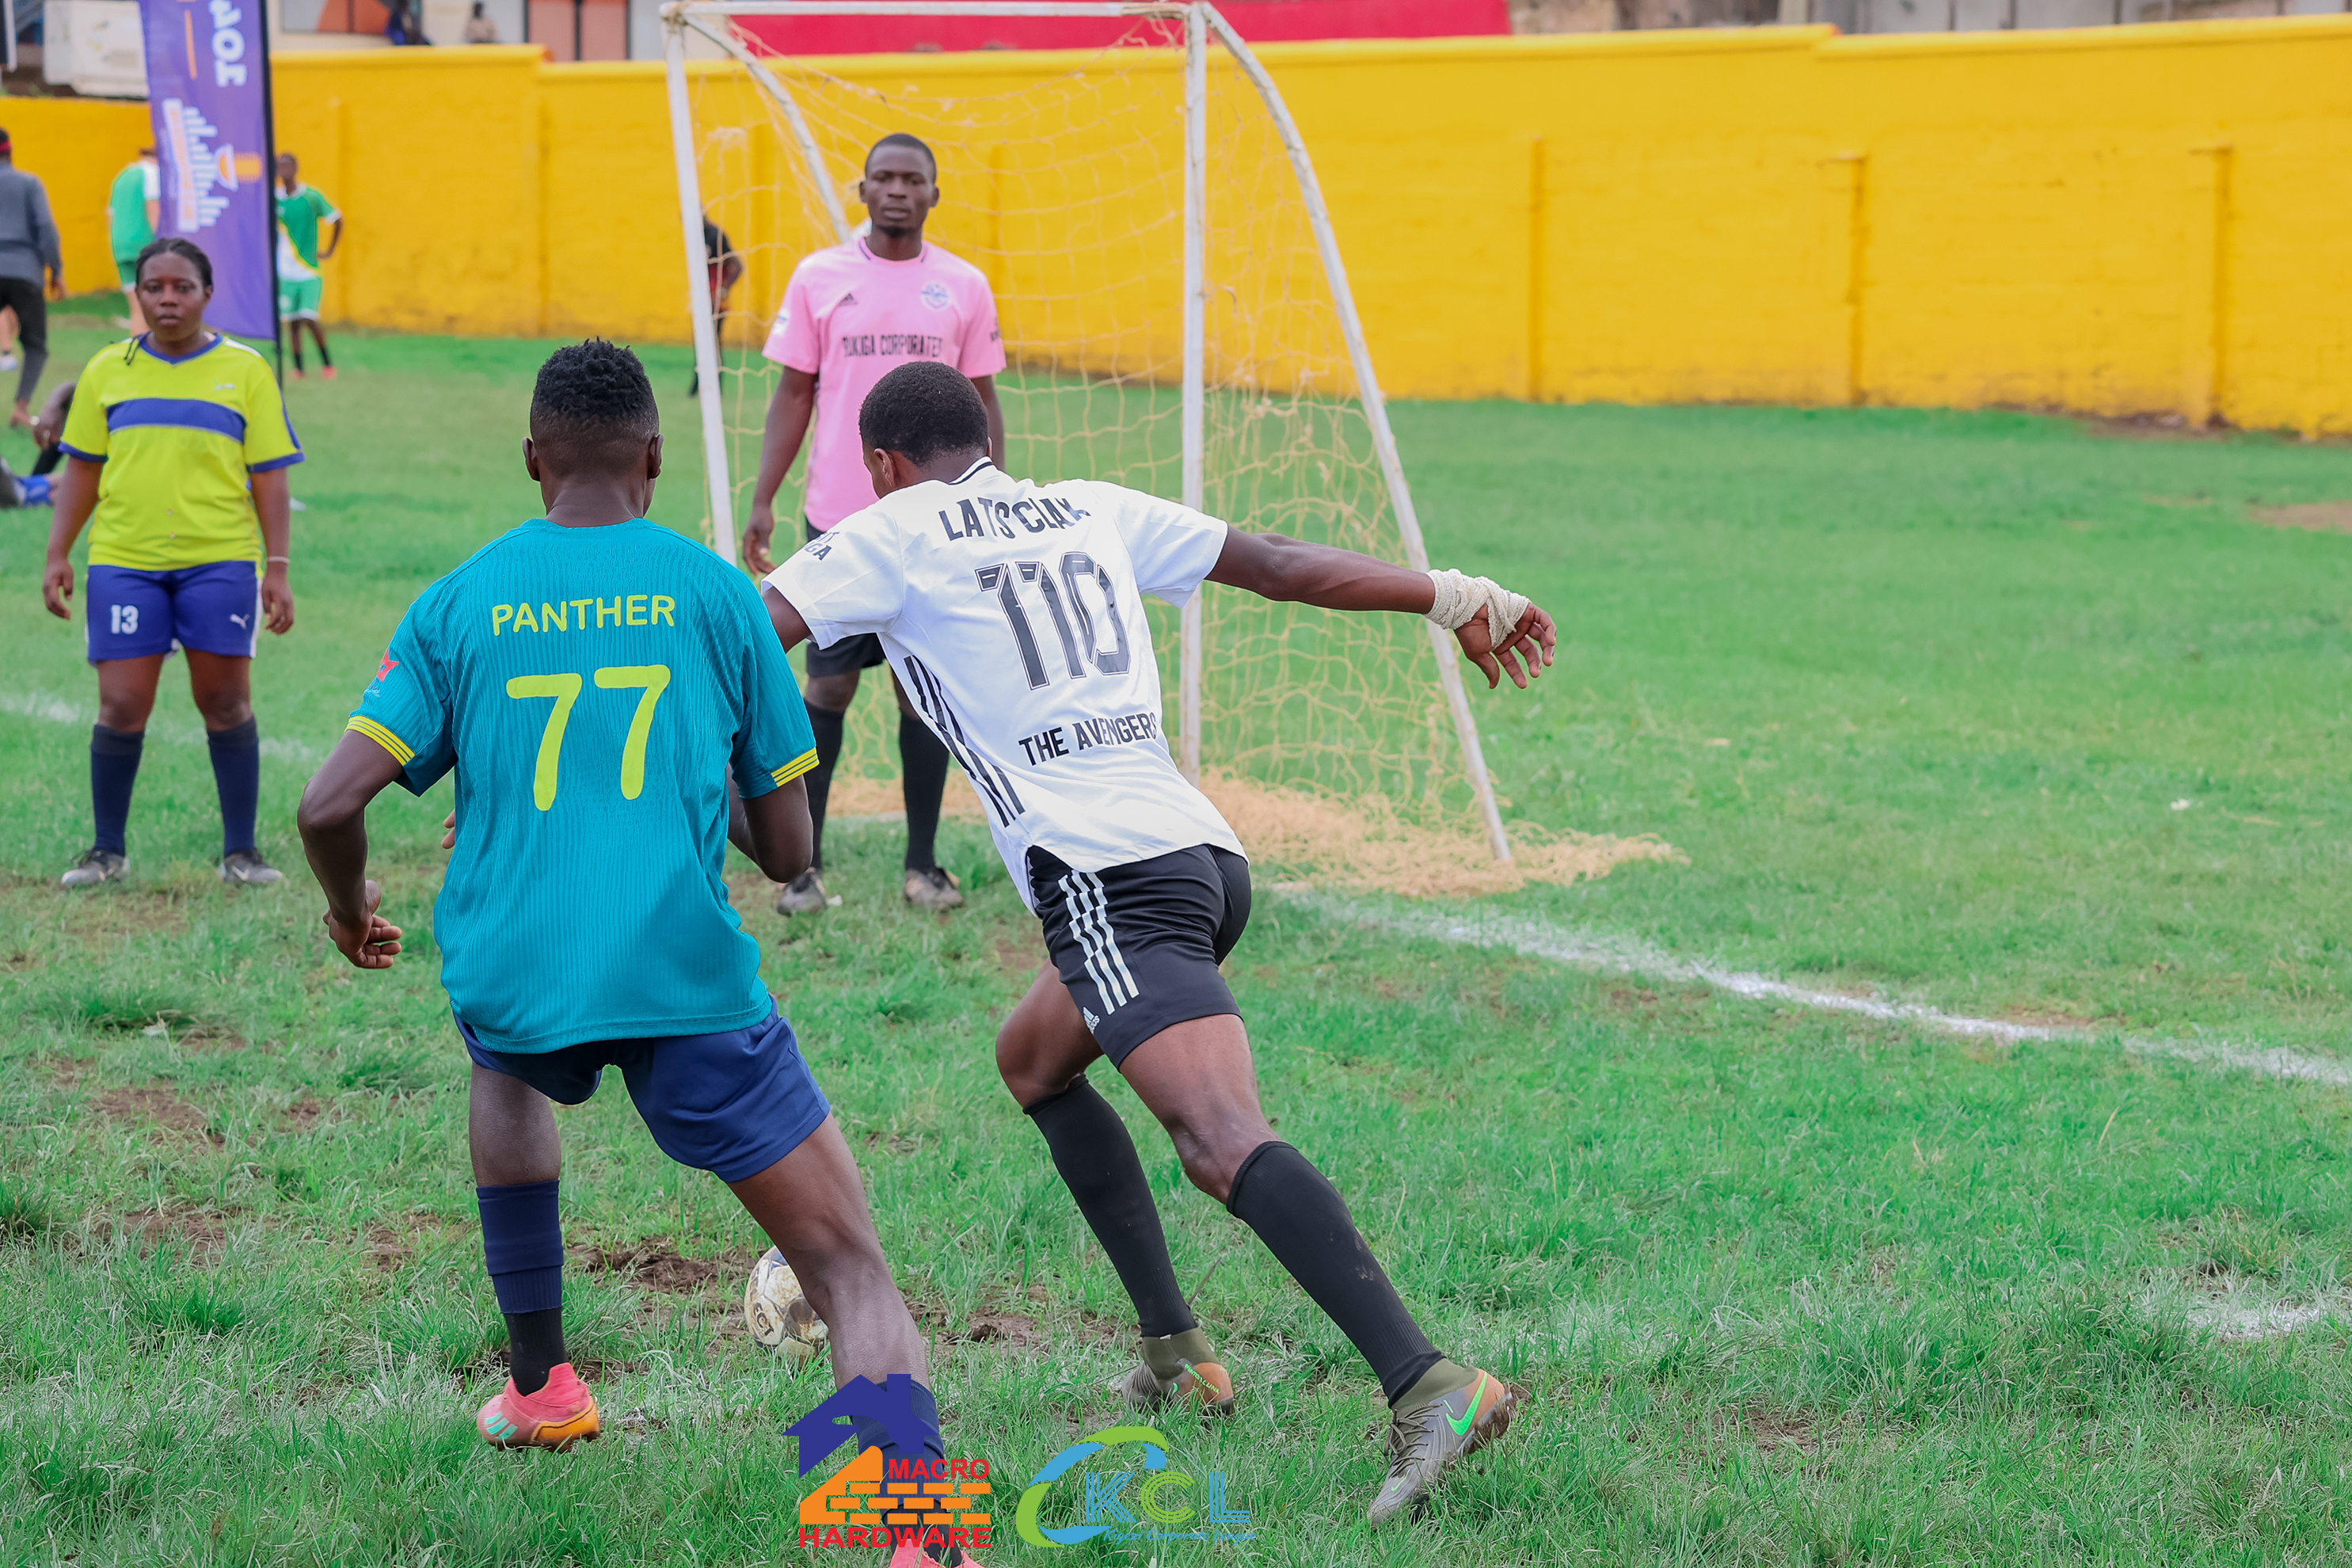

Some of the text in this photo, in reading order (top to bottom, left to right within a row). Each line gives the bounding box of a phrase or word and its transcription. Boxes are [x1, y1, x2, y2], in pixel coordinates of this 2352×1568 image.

[111, 604, 139, 634] 13
[492, 594, 676, 636] PANTHER
[974, 550, 1131, 691] 110
[506, 664, 672, 812] 77
[1018, 712, 1157, 767] THE AVENGERS
